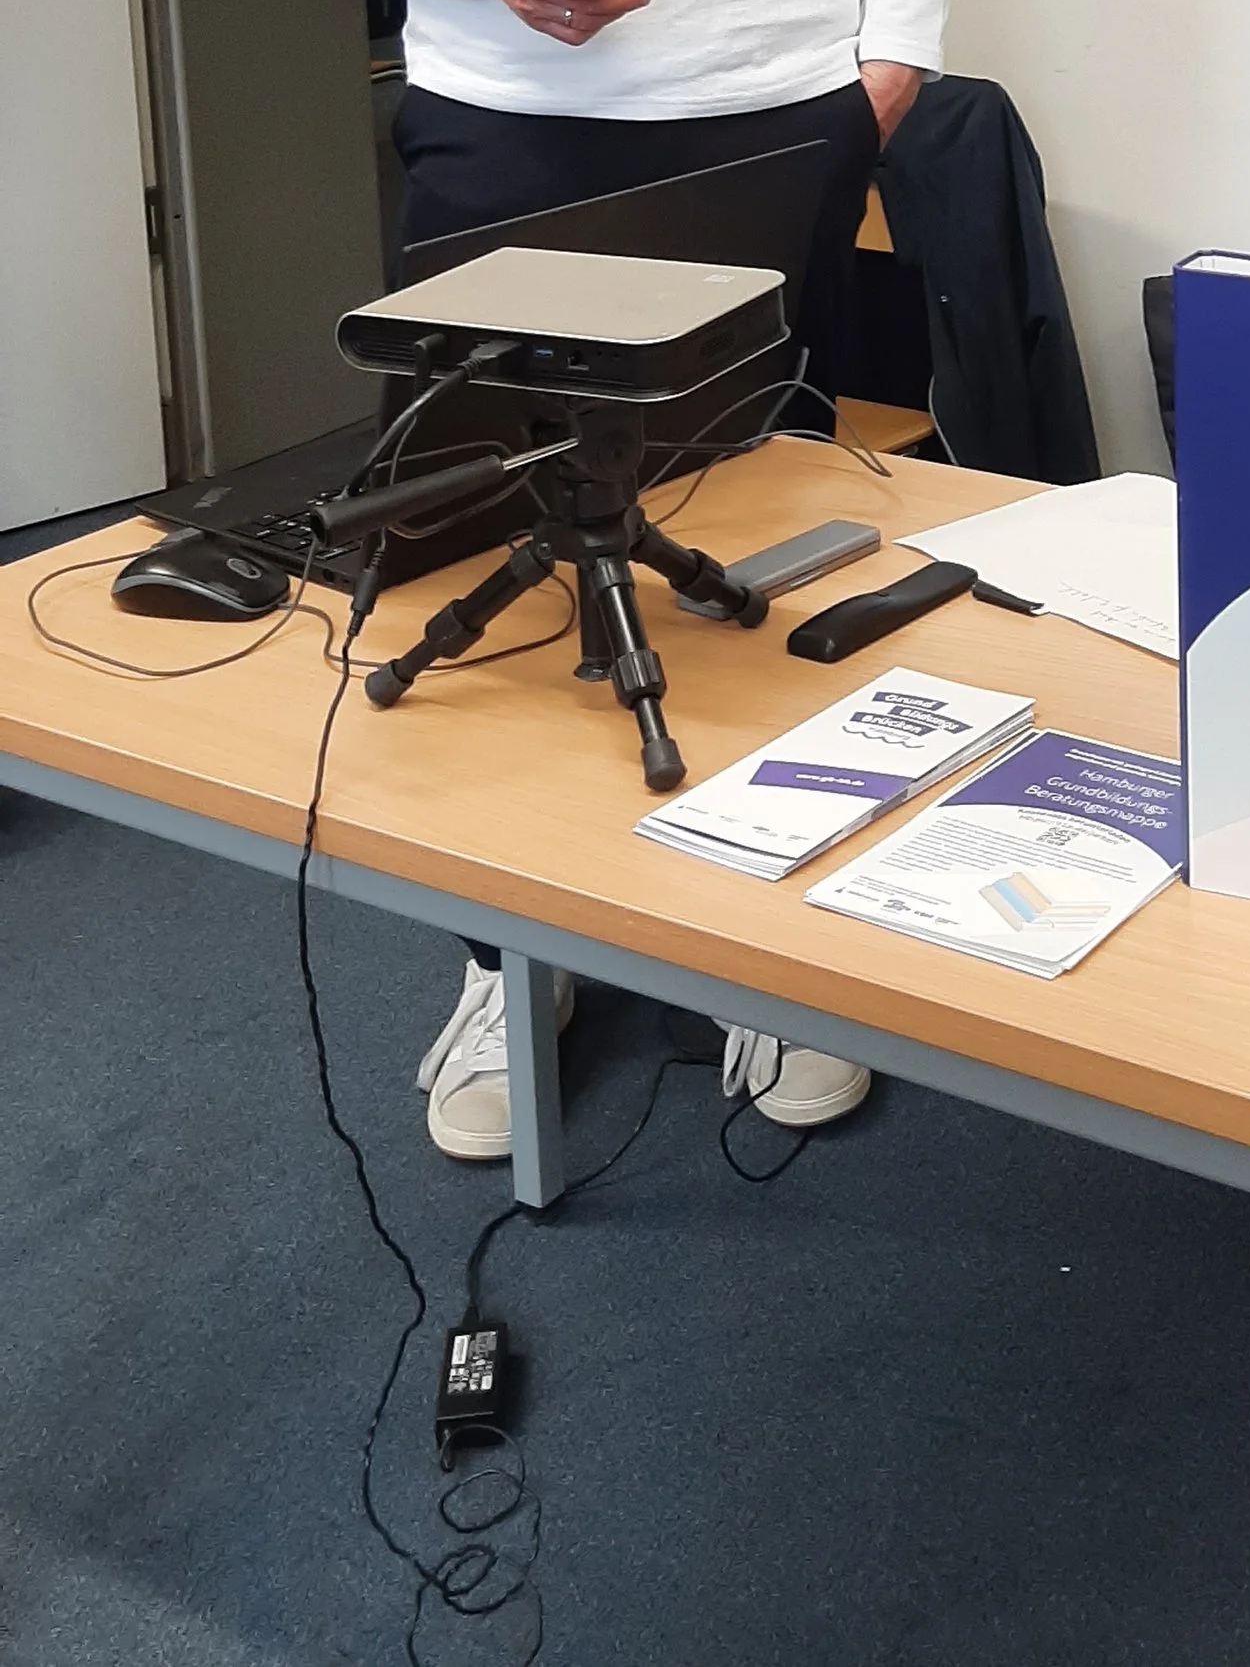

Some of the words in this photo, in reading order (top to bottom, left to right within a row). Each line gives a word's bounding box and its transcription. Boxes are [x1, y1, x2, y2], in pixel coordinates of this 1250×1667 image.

[885, 694, 937, 708] Grund
[861, 715, 922, 734] Brücken
[1046, 776, 1173, 815] Grundbildungs-
[1080, 769, 1174, 799] Hamburger
[1024, 784, 1168, 829] Beratungsmappe
